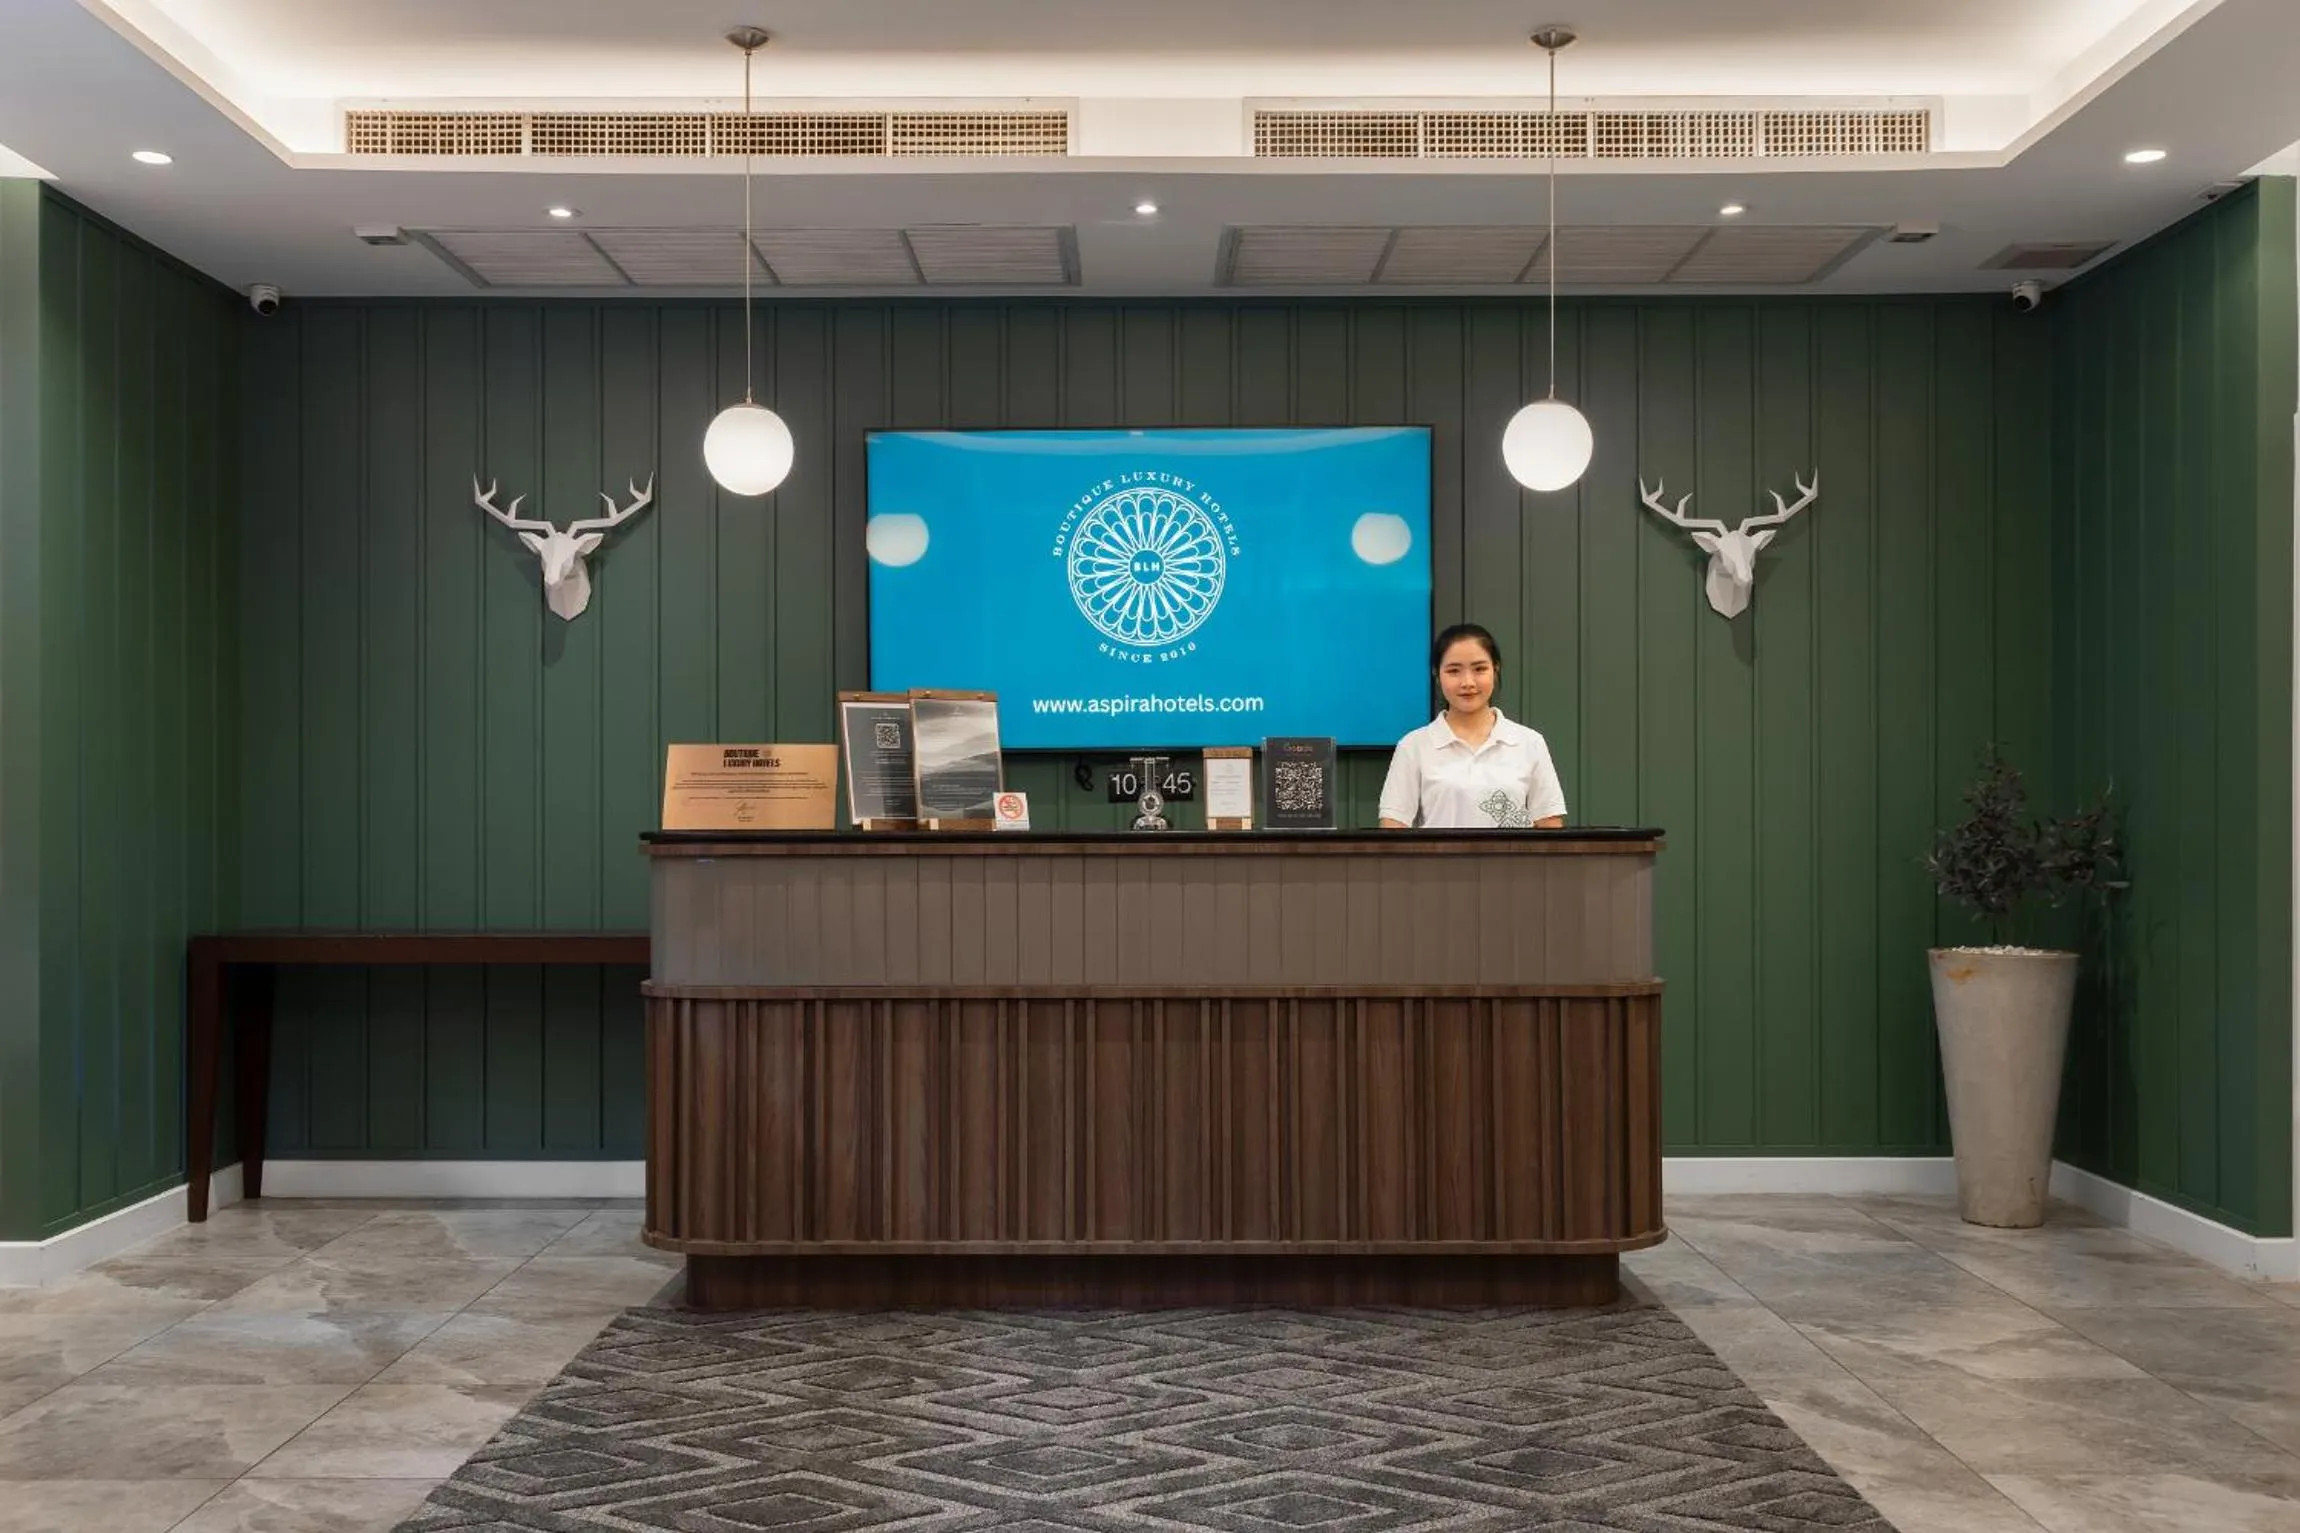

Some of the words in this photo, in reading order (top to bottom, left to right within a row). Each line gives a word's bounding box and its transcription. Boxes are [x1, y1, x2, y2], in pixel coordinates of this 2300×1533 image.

[1052, 480, 1114, 557] BOUTIQUE
[1120, 471, 1196, 492] LUXURY
[1200, 492, 1241, 557] HOTELS
[1133, 562, 1160, 571] BLH
[1098, 641, 1152, 663] SINCE
[1160, 641, 1197, 662] 2010
[1033, 694, 1264, 716] www.aspirahotels.com
[1110, 773, 1137, 795] 10
[1162, 771, 1192, 794] 45
